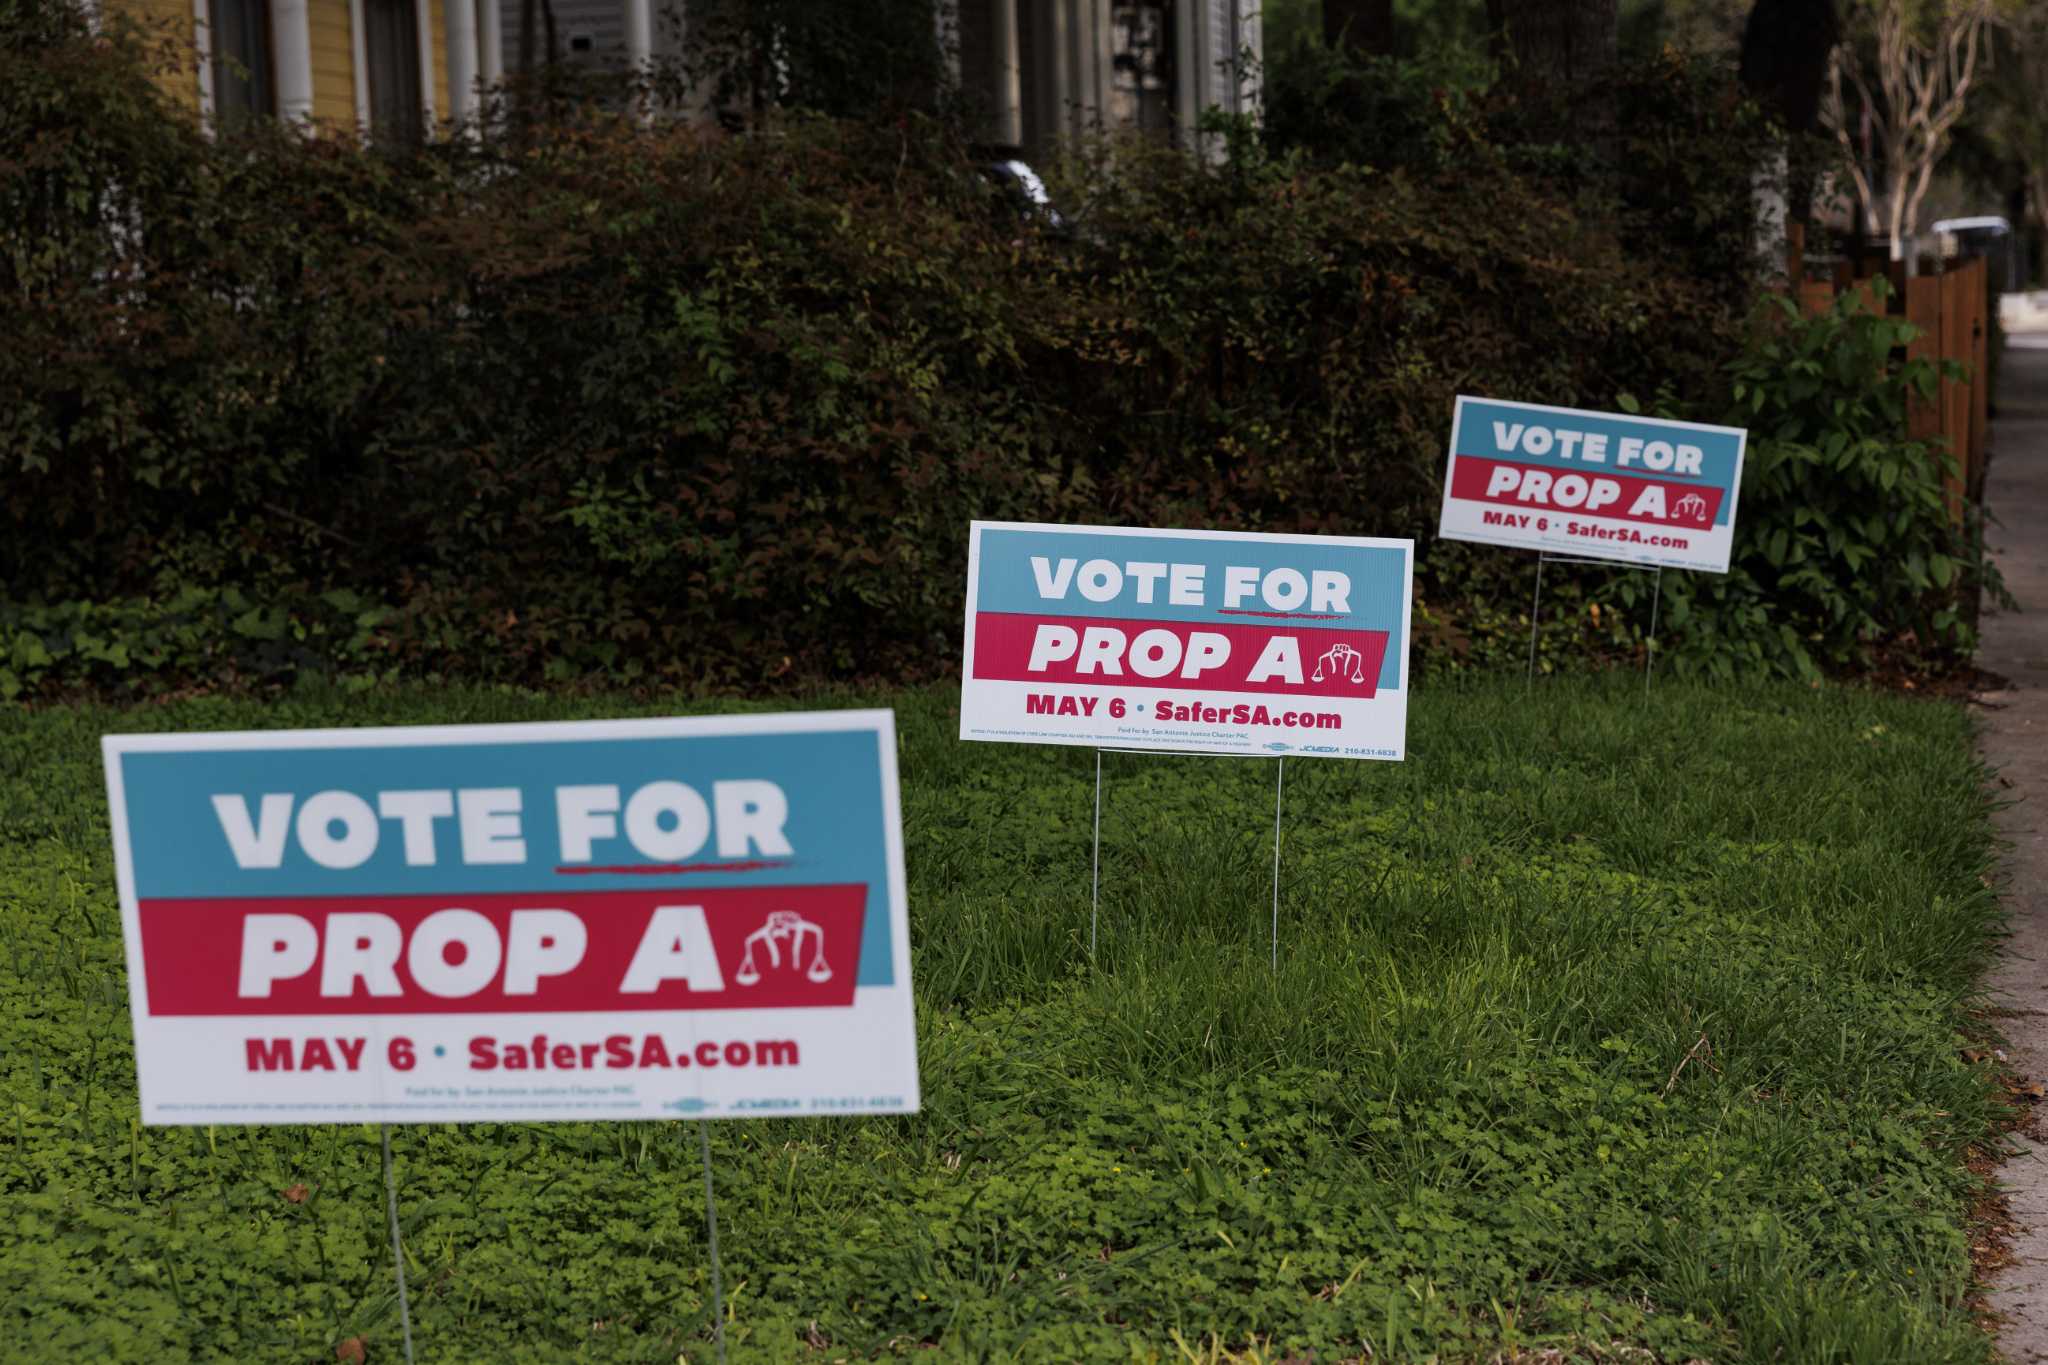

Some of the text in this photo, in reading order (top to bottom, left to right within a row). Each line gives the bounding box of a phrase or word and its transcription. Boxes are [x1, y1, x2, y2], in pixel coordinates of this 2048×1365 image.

[1492, 421, 1703, 475] VOTE FOR
[1486, 466, 1667, 519] PROP A
[1483, 511, 1530, 529] MAY
[1536, 518, 1548, 532] 6
[1567, 521, 1689, 549] SaferSA.com
[1030, 556, 1352, 613] VOTE FOR
[1027, 624, 1305, 684] PROP A
[1026, 693, 1342, 730] MAY 6 SaferSA.com
[211, 780, 793, 869] VOTE FOR
[238, 905, 725, 998] PROP A
[246, 1034, 801, 1073] MAY 6 SaferSA.com
